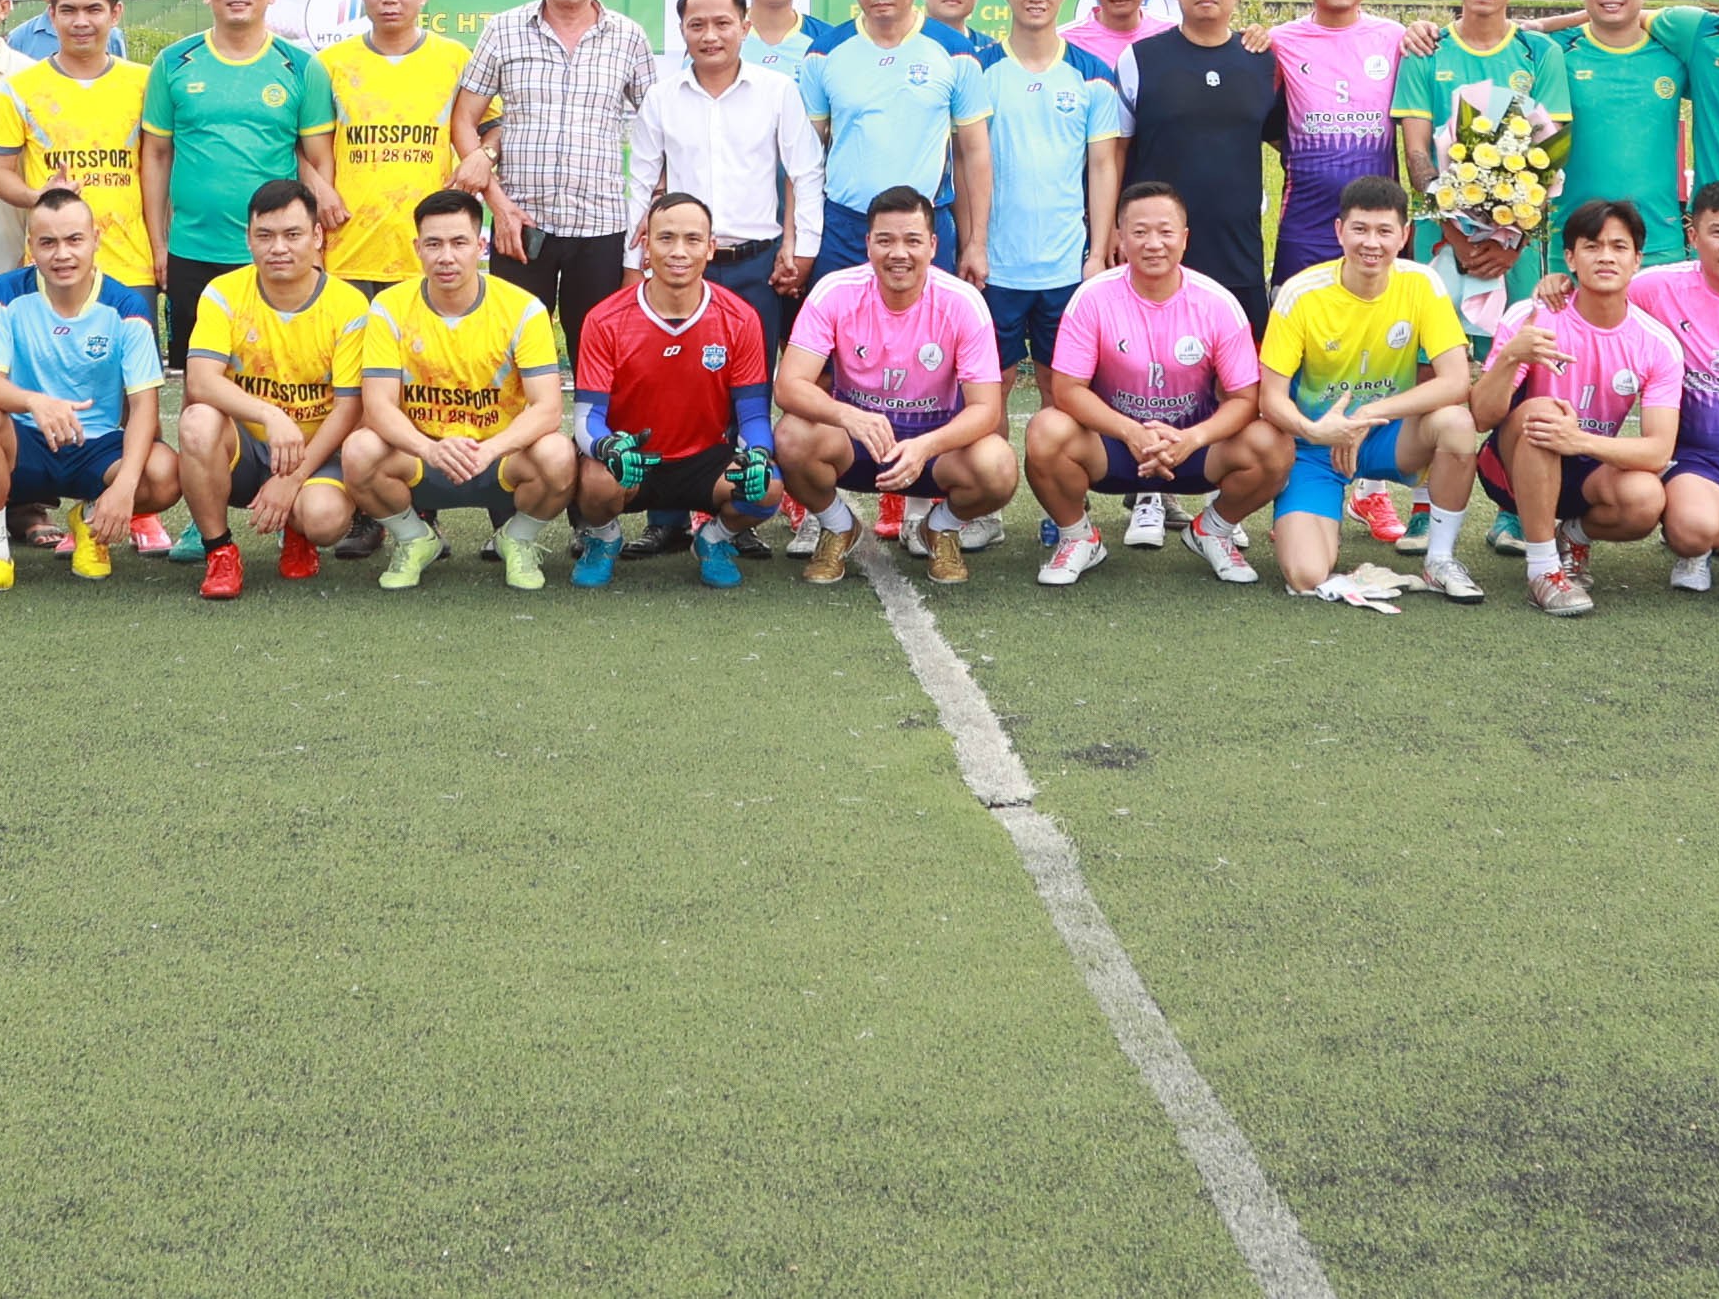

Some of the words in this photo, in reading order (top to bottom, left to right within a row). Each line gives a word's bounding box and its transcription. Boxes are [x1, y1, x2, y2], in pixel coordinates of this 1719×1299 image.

[416, 12, 448, 33] FC
[457, 12, 493, 33] HT
[1305, 113, 1332, 123] HTQ
[1336, 112, 1383, 122] GROUP
[346, 124, 440, 146] KKITSSPORT
[349, 147, 378, 164] 0911
[381, 147, 401, 164] 28
[403, 148, 435, 165] 6789
[83, 172, 100, 187] 28
[104, 172, 131, 188] 6789
[234, 373, 329, 404] KKITSSPORT
[883, 367, 907, 391] 17
[1354, 378, 1393, 391] GROU
[403, 383, 501, 407] KKITSSPORT
[885, 396, 938, 409] GROUP
[1117, 389, 1145, 408] HTQ
[1149, 391, 1195, 409] GROUP
[408, 407, 443, 424] 0911
[447, 410, 467, 425] 28
[469, 410, 500, 429] 6789
